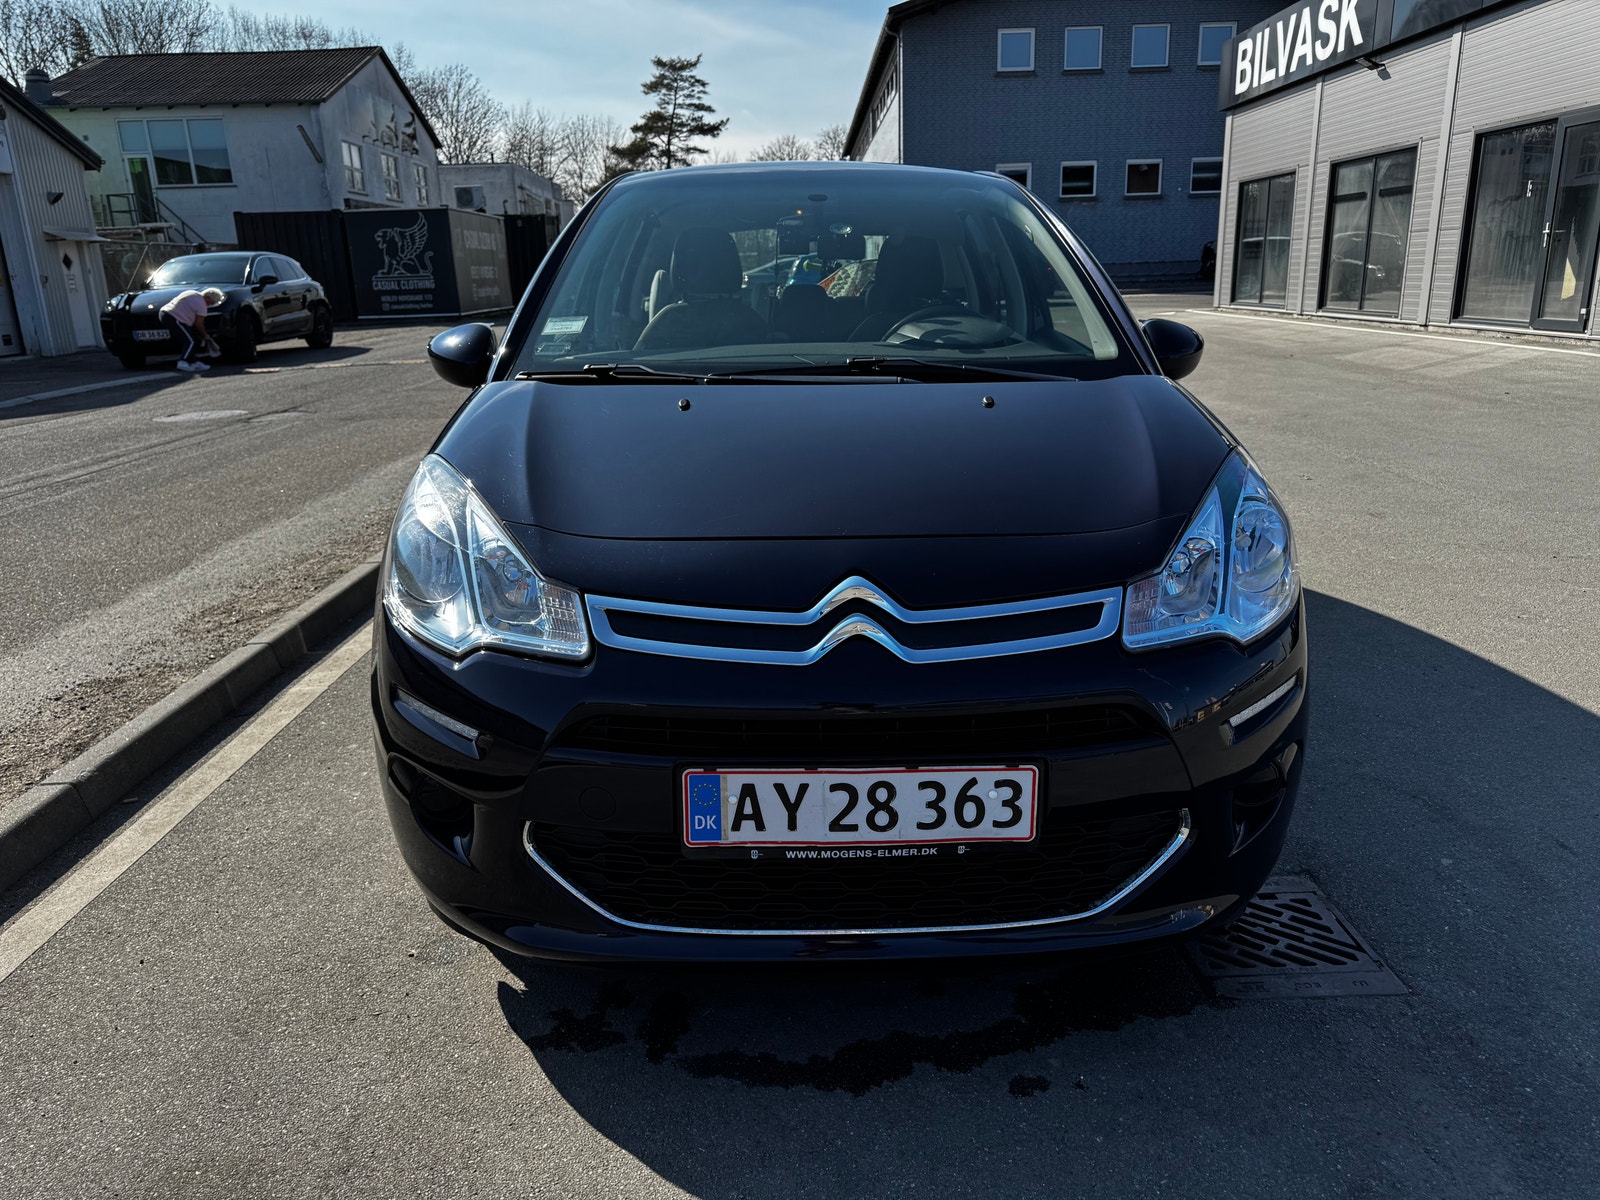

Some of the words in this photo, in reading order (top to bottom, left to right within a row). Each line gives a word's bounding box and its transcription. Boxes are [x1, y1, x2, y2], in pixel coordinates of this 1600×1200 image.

[1235, 0, 1364, 95] BILVASK
[372, 281, 400, 290] CASUAL
[400, 280, 435, 290] CLOTHING
[730, 783, 810, 832] AY
[828, 780, 899, 833] 28
[916, 777, 1023, 830] 363
[694, 815, 717, 830] DK
[785, 847, 938, 859] WWW.MOGENS-ELMER.DK
